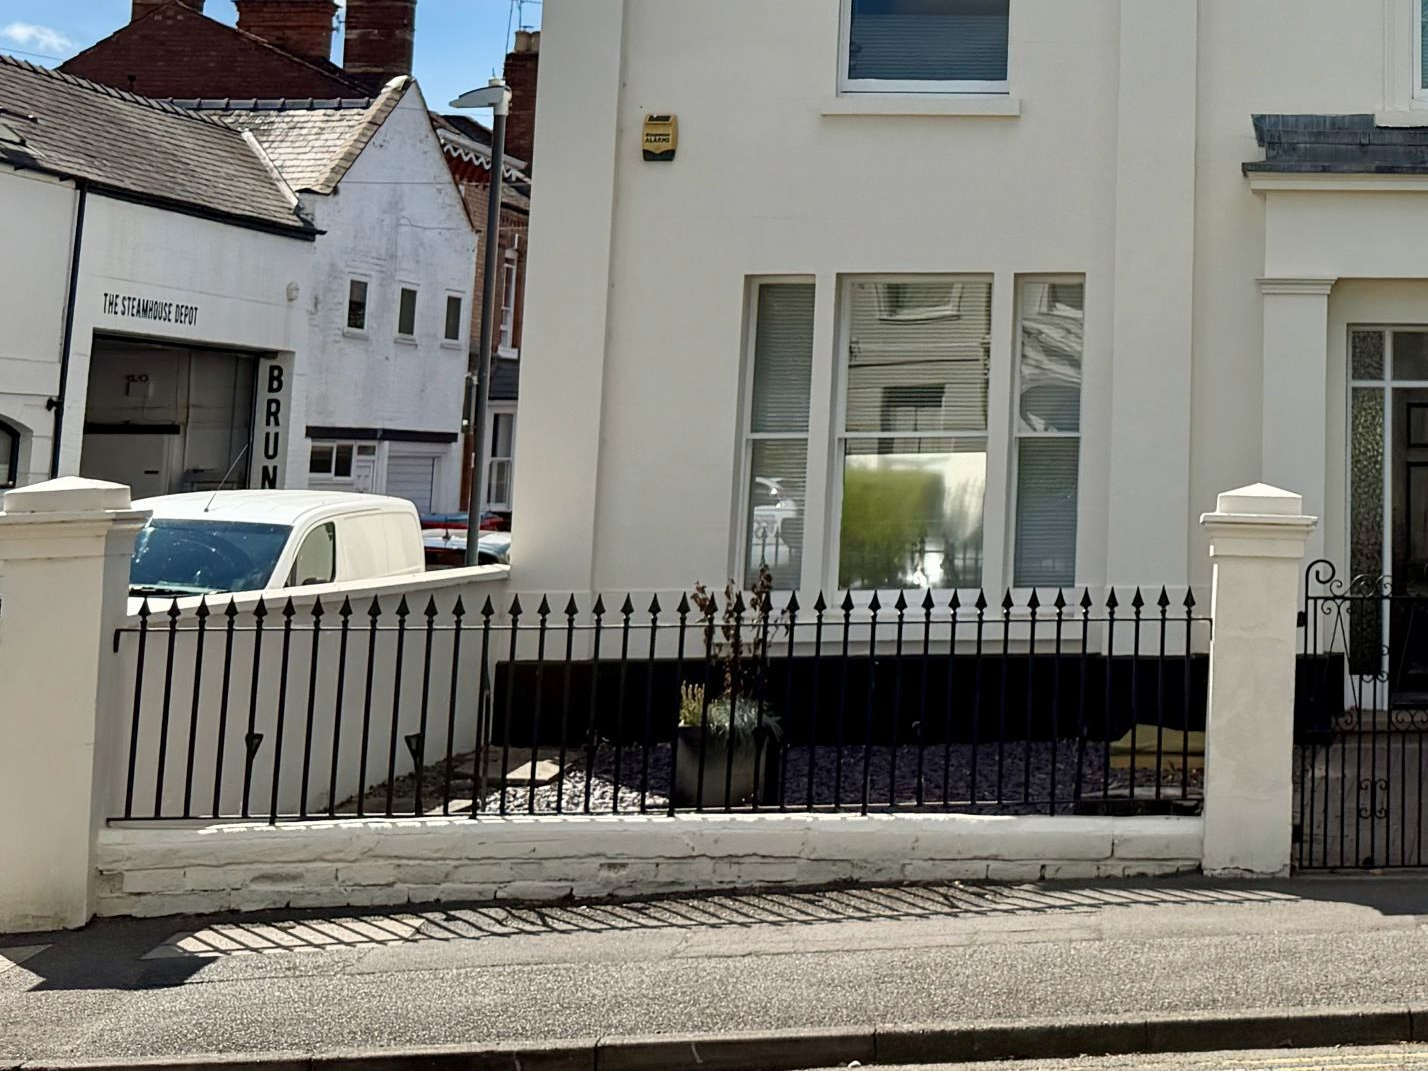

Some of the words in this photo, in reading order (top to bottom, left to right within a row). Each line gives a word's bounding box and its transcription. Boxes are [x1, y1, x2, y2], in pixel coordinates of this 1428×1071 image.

[103, 292, 118, 315] THE
[121, 296, 172, 323] STEAMHOUSE
[175, 303, 199, 326] DEPOT
